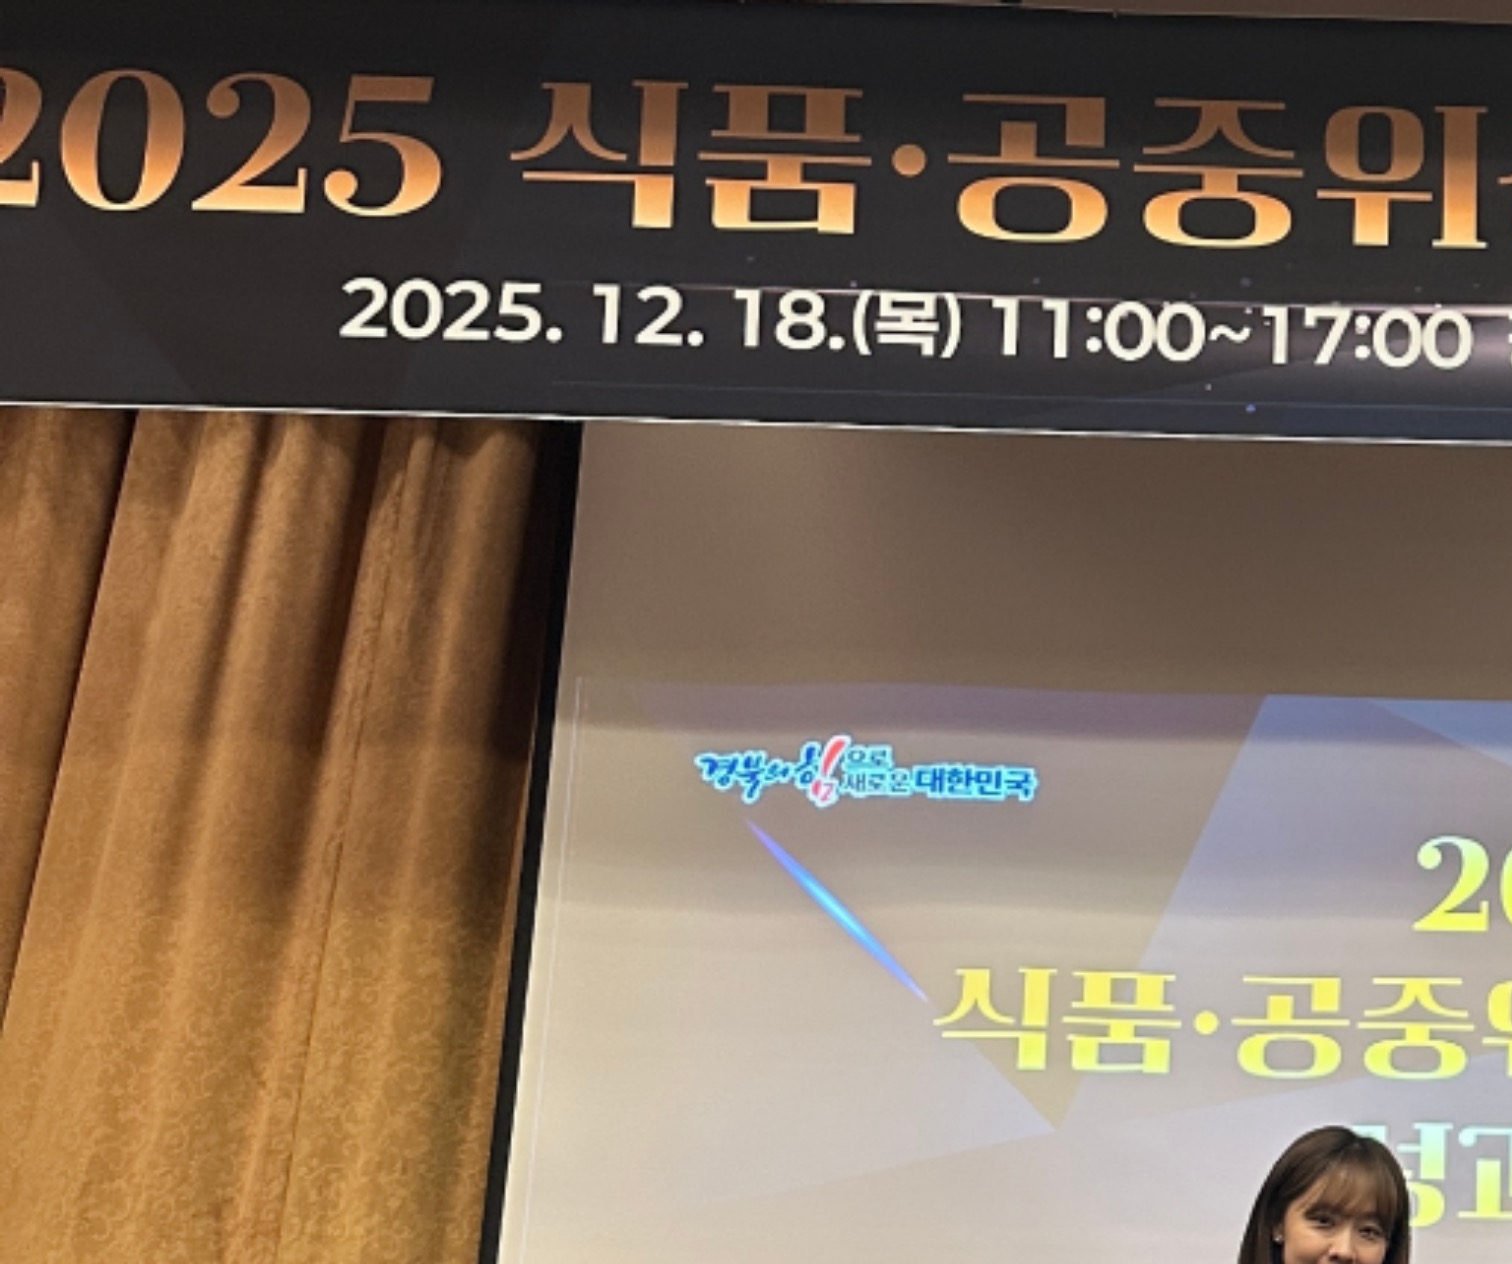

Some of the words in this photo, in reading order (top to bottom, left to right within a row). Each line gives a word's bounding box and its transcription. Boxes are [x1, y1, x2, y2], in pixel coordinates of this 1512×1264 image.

[339, 276, 562, 344] 2025.
[594, 284, 704, 347] 12.
[734, 288, 961, 358] 18.(목)
[991, 298, 1474, 370] 11:00~17:00
[911, 763, 1040, 802] 대한민국
